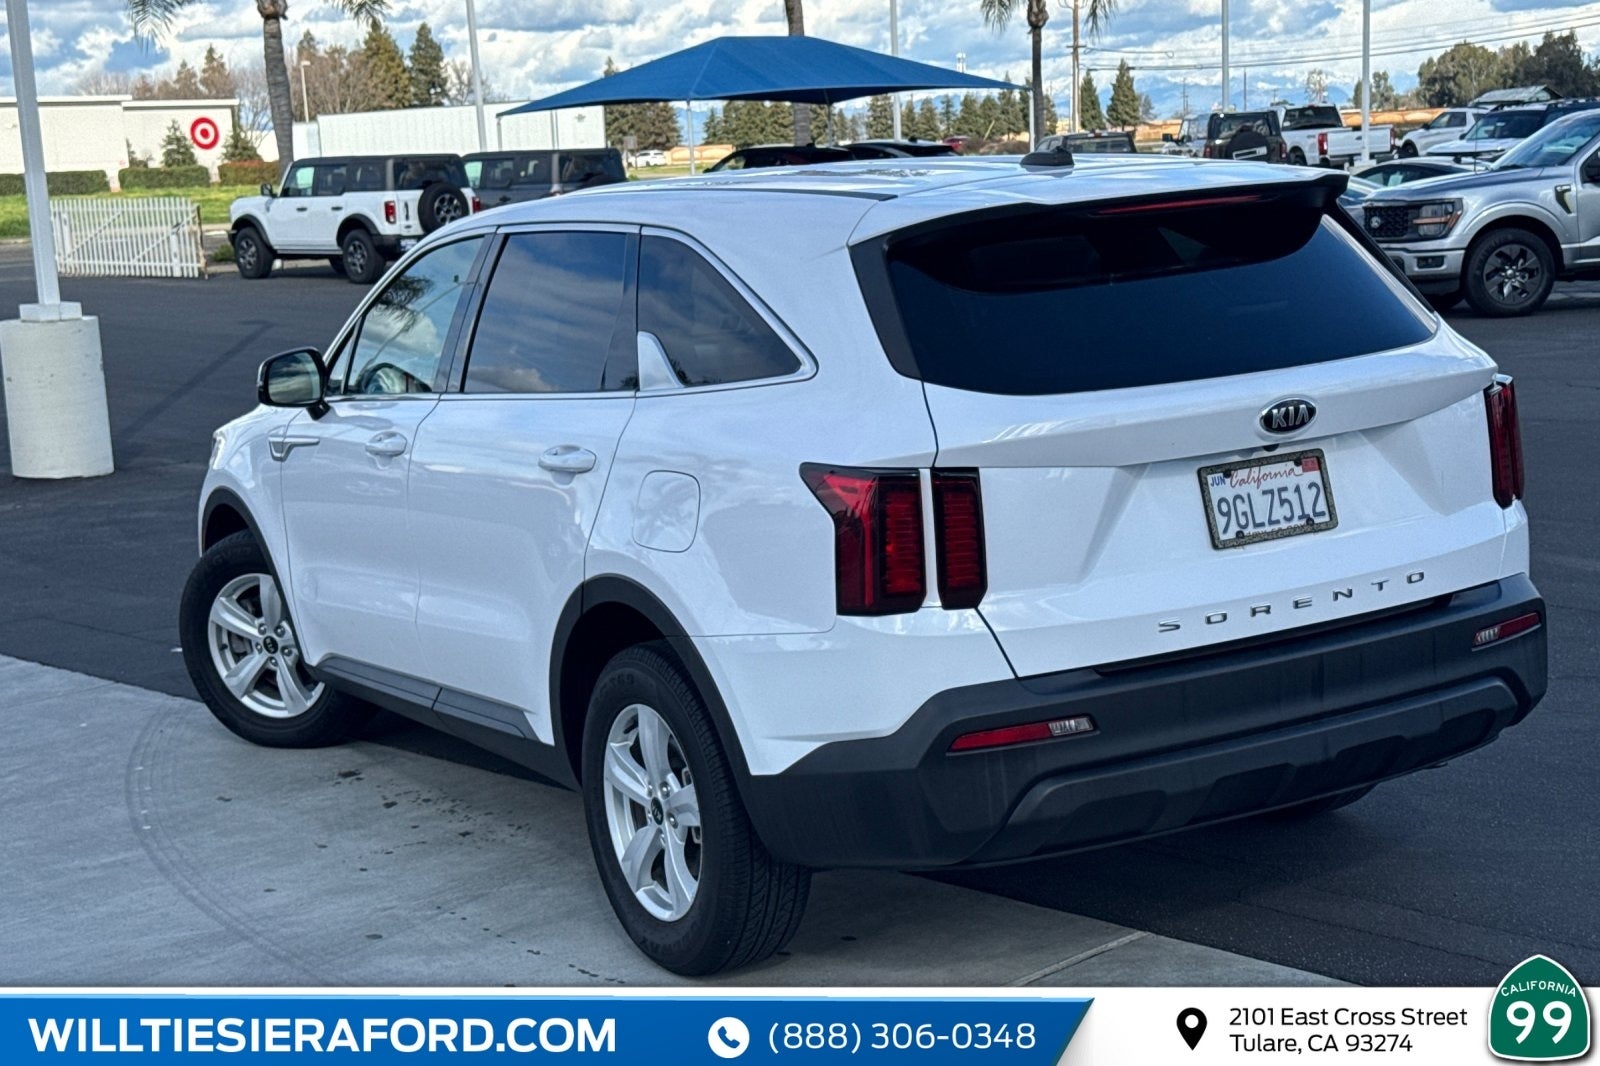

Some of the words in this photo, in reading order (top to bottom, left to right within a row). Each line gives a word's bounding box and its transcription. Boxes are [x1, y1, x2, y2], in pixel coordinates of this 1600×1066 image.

[1271, 404, 1310, 429] KIA
[1210, 475, 1226, 487] JUN
[1229, 466, 1303, 489] California
[1217, 482, 1326, 534] 9GLZ512
[1158, 571, 1425, 633] SORENTO
